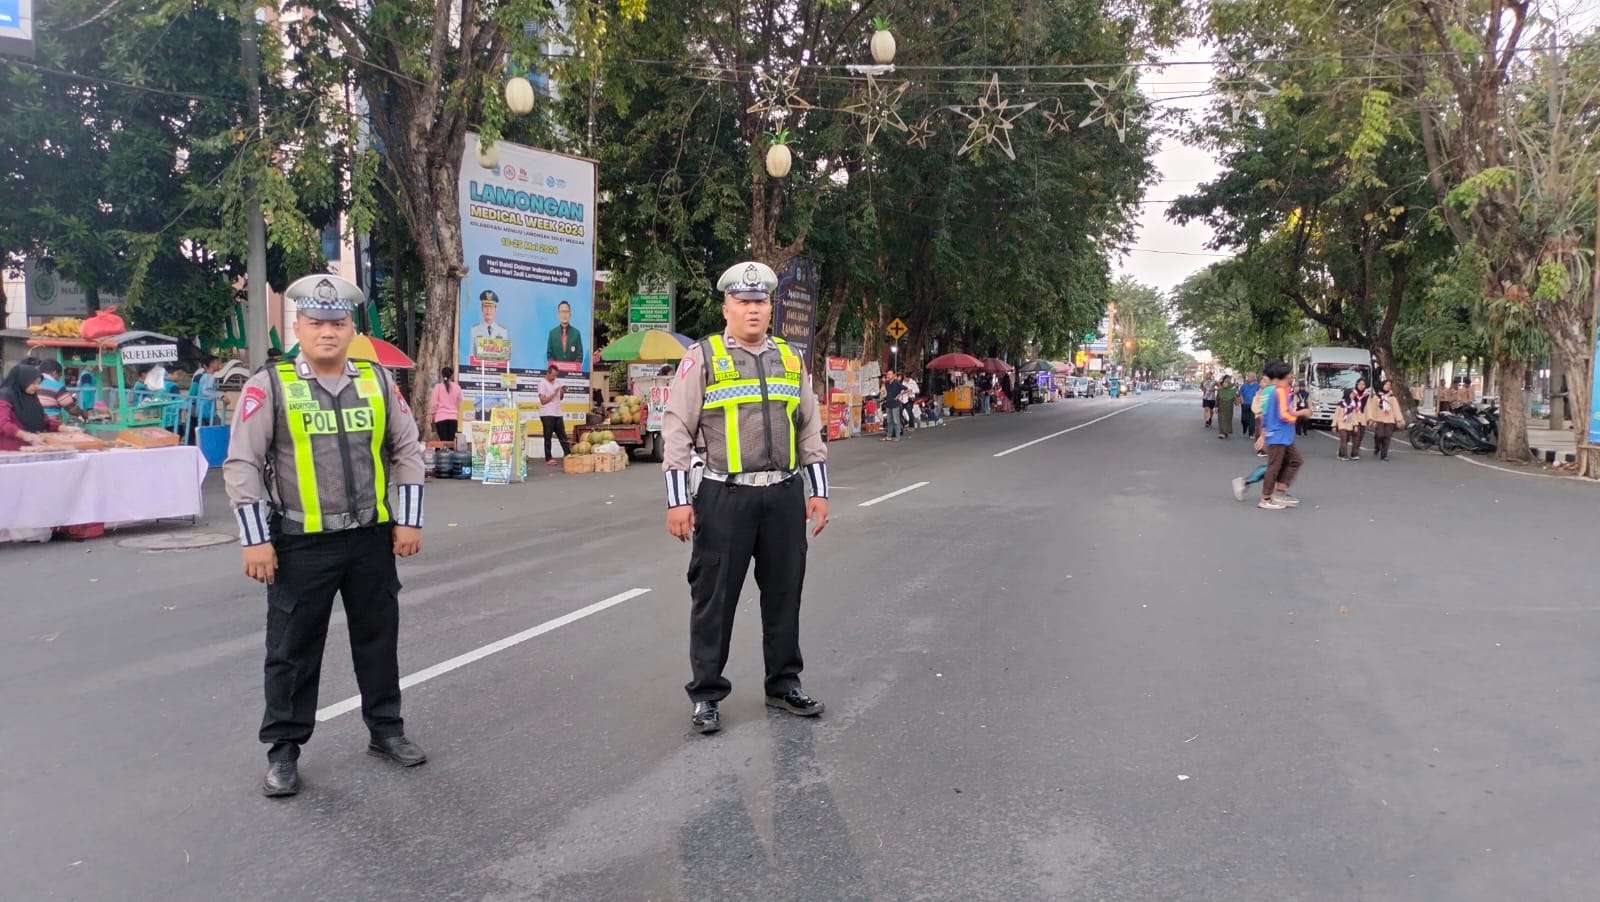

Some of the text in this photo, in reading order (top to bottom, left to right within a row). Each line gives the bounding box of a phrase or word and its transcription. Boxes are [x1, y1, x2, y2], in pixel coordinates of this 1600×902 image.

[470, 181, 584, 221] LAMONGAN
[469, 204, 585, 238] MEDICAL WEEK 2024
[524, 241, 539, 251] Mei
[539, 243, 558, 254] 2024
[486, 259, 499, 267] Hari
[532, 265, 556, 275] Indonesia
[525, 272, 551, 281] Lamongan
